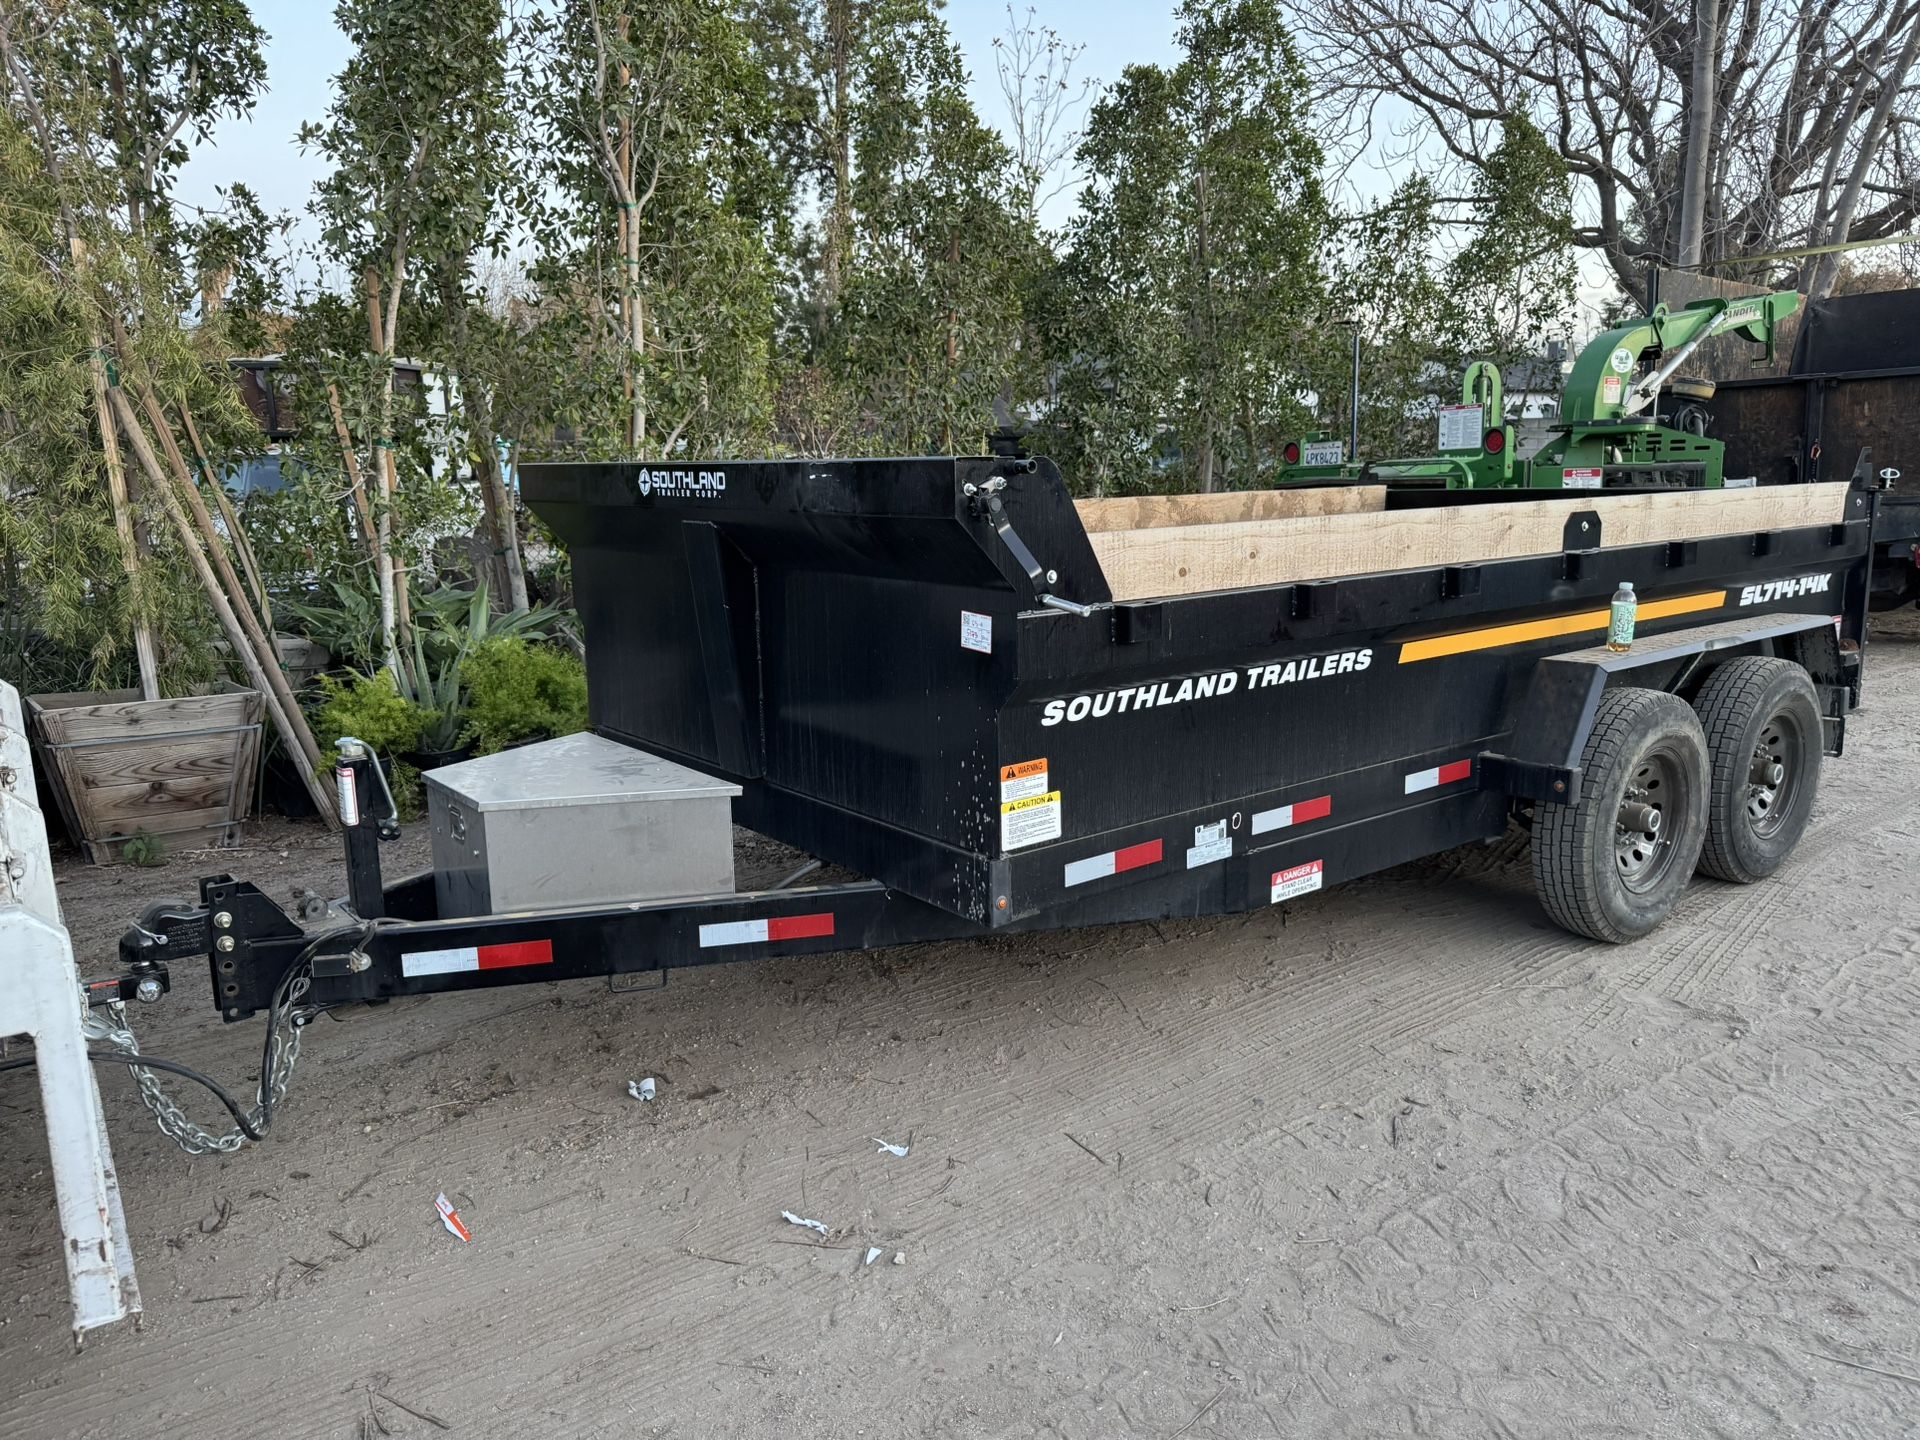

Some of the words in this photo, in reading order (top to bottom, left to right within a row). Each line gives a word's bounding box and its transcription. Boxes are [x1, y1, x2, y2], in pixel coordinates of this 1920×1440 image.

[651, 471, 726, 489] SOUTHLAND
[657, 489, 690, 497] TRAILER
[695, 489, 722, 498] CORP.
[1739, 573, 1832, 606] SL714-14K
[1041, 671, 1238, 727] SOUTHLAND
[1247, 649, 1374, 690] TRAILERS
[1018, 761, 1043, 774] WARNING
[1016, 796, 1046, 810] CAUTION
[1283, 866, 1311, 881] DANGER
